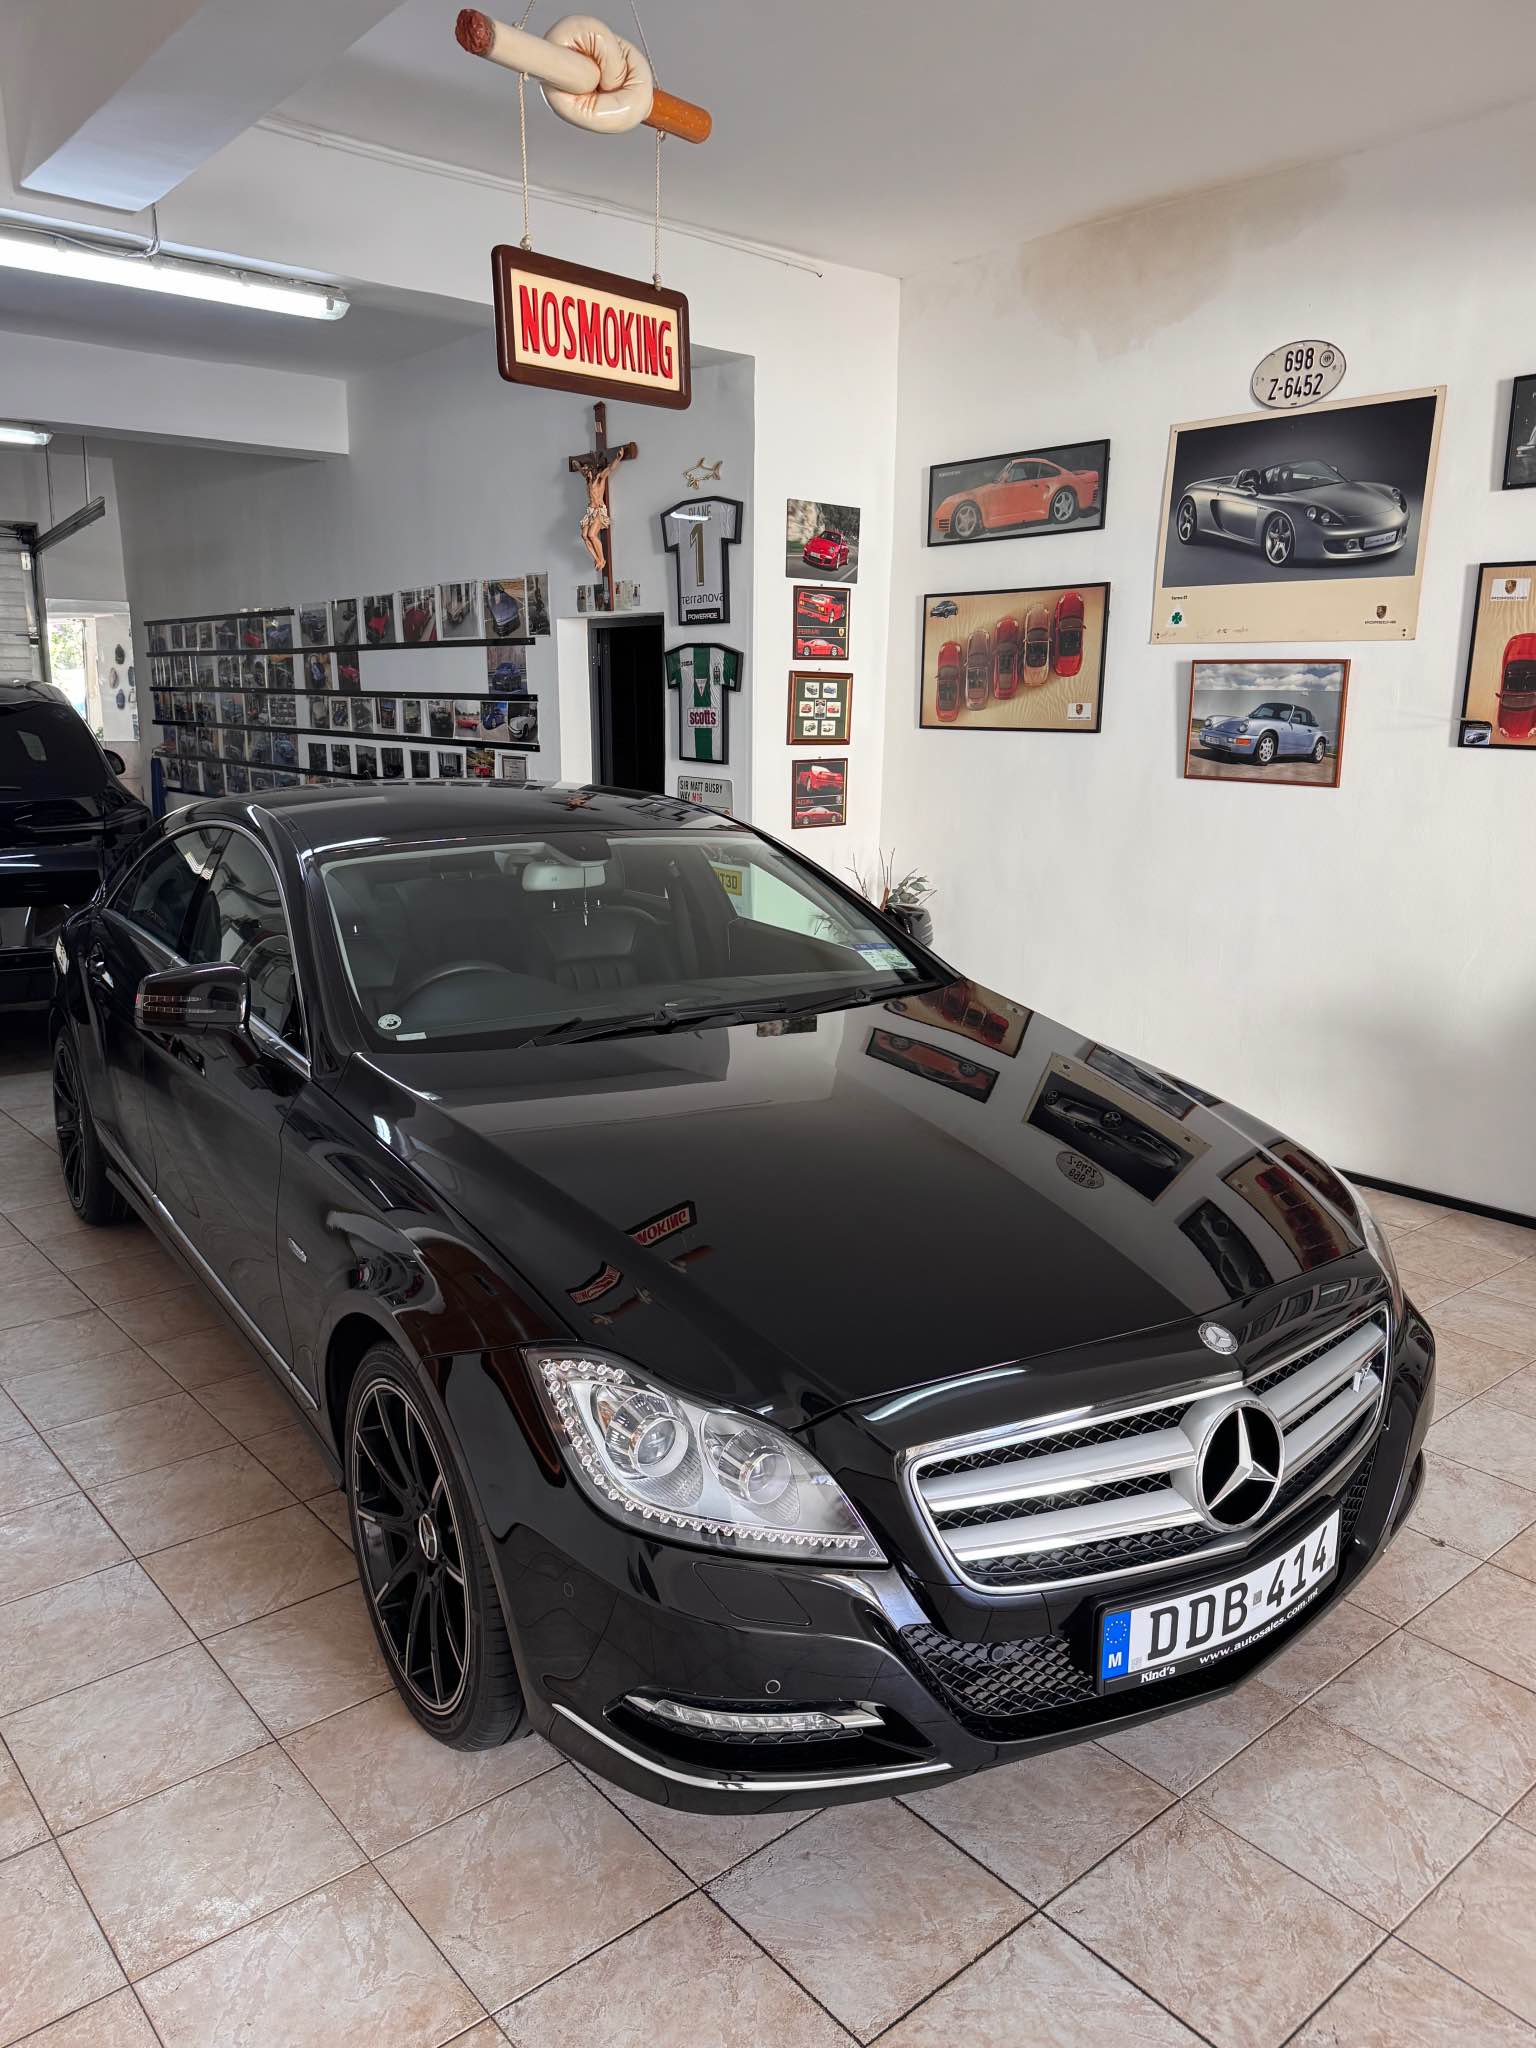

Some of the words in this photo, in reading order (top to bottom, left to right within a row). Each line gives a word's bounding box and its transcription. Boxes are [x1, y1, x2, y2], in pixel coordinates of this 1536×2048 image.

[1284, 347, 1314, 373] 698
[1268, 373, 1324, 401] Z-6452
[690, 522, 705, 587] 1
[687, 611, 719, 620] POWERADE
[689, 709, 717, 725] scotts
[680, 780, 689, 790] SIR
[690, 781, 703, 792] MATT
[704, 782, 722, 794] BUSBY
[1147, 1582, 1248, 1661] DDB
[1265, 1524, 1327, 1609] 414
[1140, 1666, 1176, 1684] Kind's
[1199, 1587, 1319, 1664] www.autosales.com.mt
[1107, 1651, 1122, 1669] M
